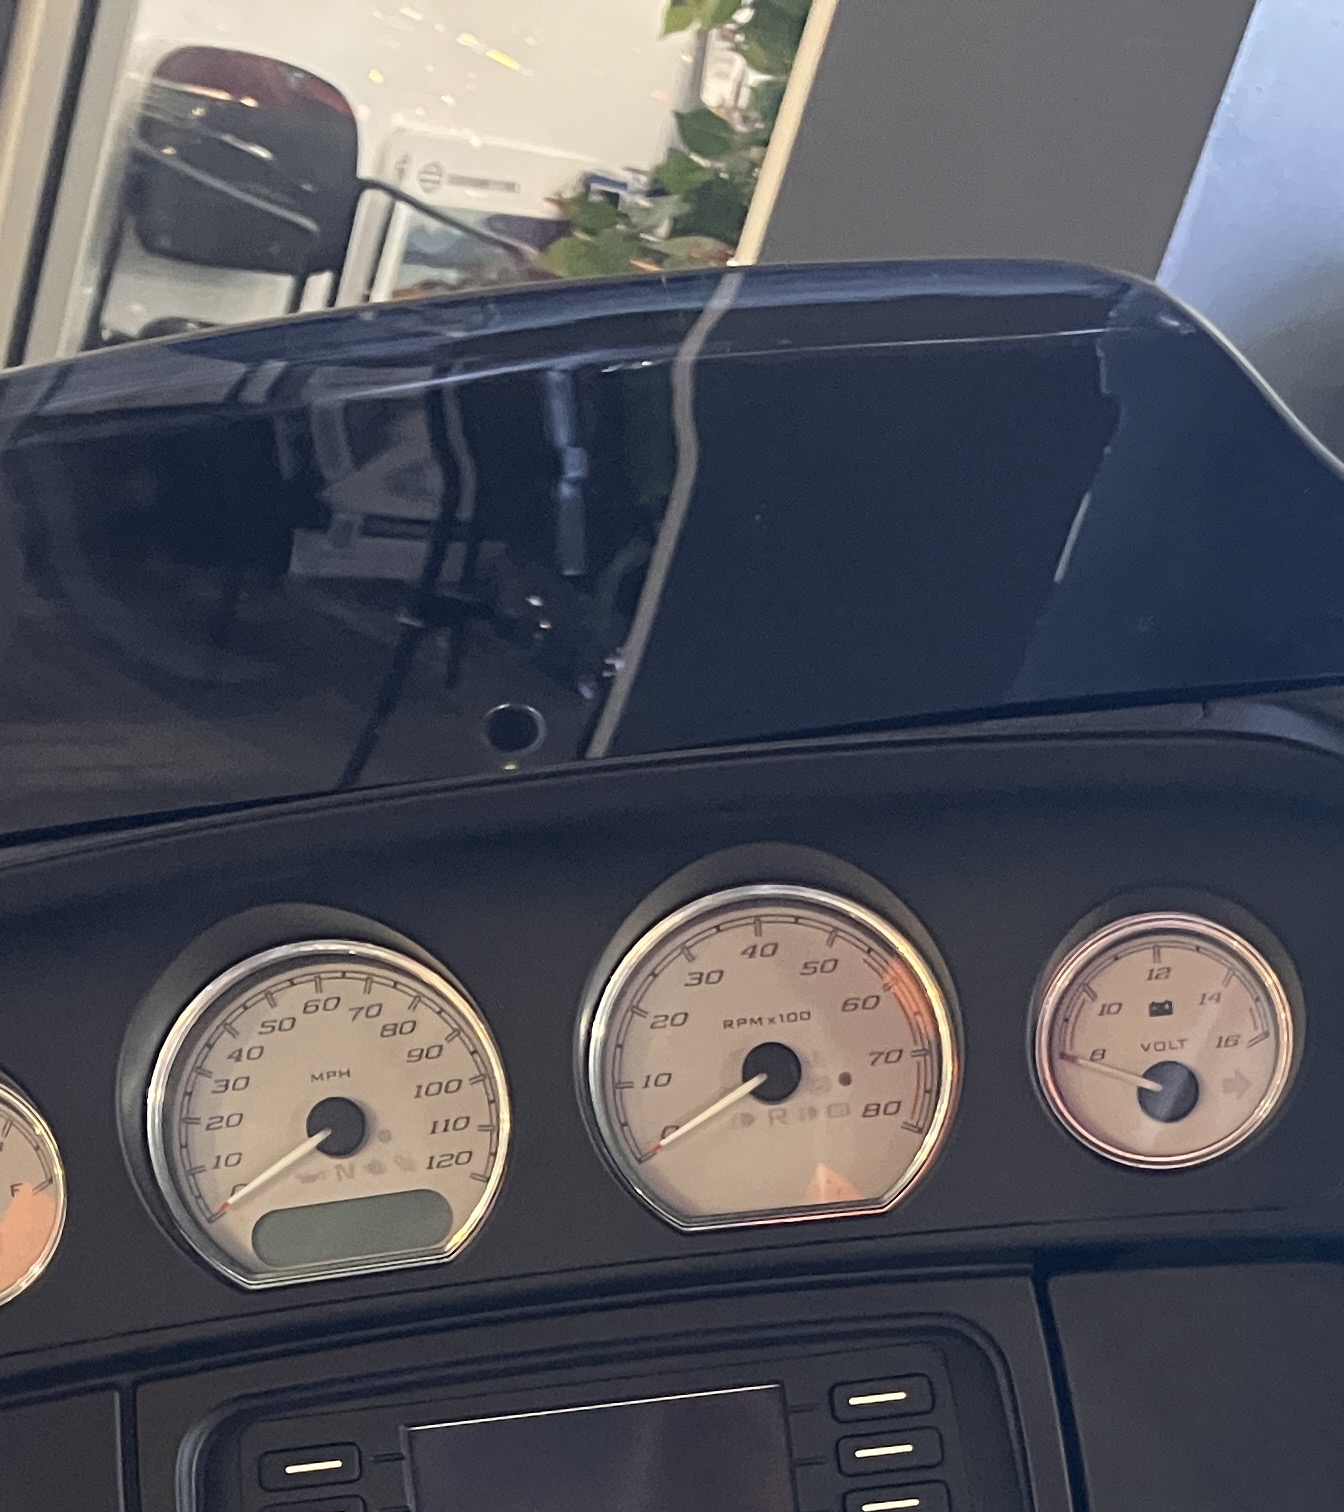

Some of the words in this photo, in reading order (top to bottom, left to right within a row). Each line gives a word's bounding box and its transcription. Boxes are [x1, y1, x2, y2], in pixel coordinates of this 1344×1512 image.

[740, 942, 778, 959] 40
[799, 959, 838, 975] 50
[1146, 967, 1171, 981] 12
[684, 970, 724, 987] 30
[302, 997, 341, 1014] 60
[841, 995, 880, 1012] 60
[1199, 993, 1221, 1005] 14
[348, 1003, 383, 1021] 70
[1098, 1003, 1122, 1016] 10
[258, 1017, 296, 1035] 50
[650, 1012, 688, 1029] 20
[380, 1021, 416, 1038] 80
[1140, 1039, 1188, 1052] VOLT
[1215, 1035, 1240, 1048] 16
[226, 1046, 264, 1062] 40
[406, 1044, 443, 1063] 90
[868, 1049, 903, 1066] 70
[1090, 1050, 1106, 1061] 8
[310, 1069, 351, 1082] MPH
[641, 1073, 672, 1089] 10
[211, 1076, 250, 1094] 30
[413, 1079, 462, 1099] 100
[862, 1101, 902, 1118] 80
[205, 1113, 243, 1131] 20
[429, 1116, 471, 1134] 110
[212, 1152, 243, 1169] 10
[425, 1151, 472, 1170] 120
[10, 1183, 23, 1197] F
